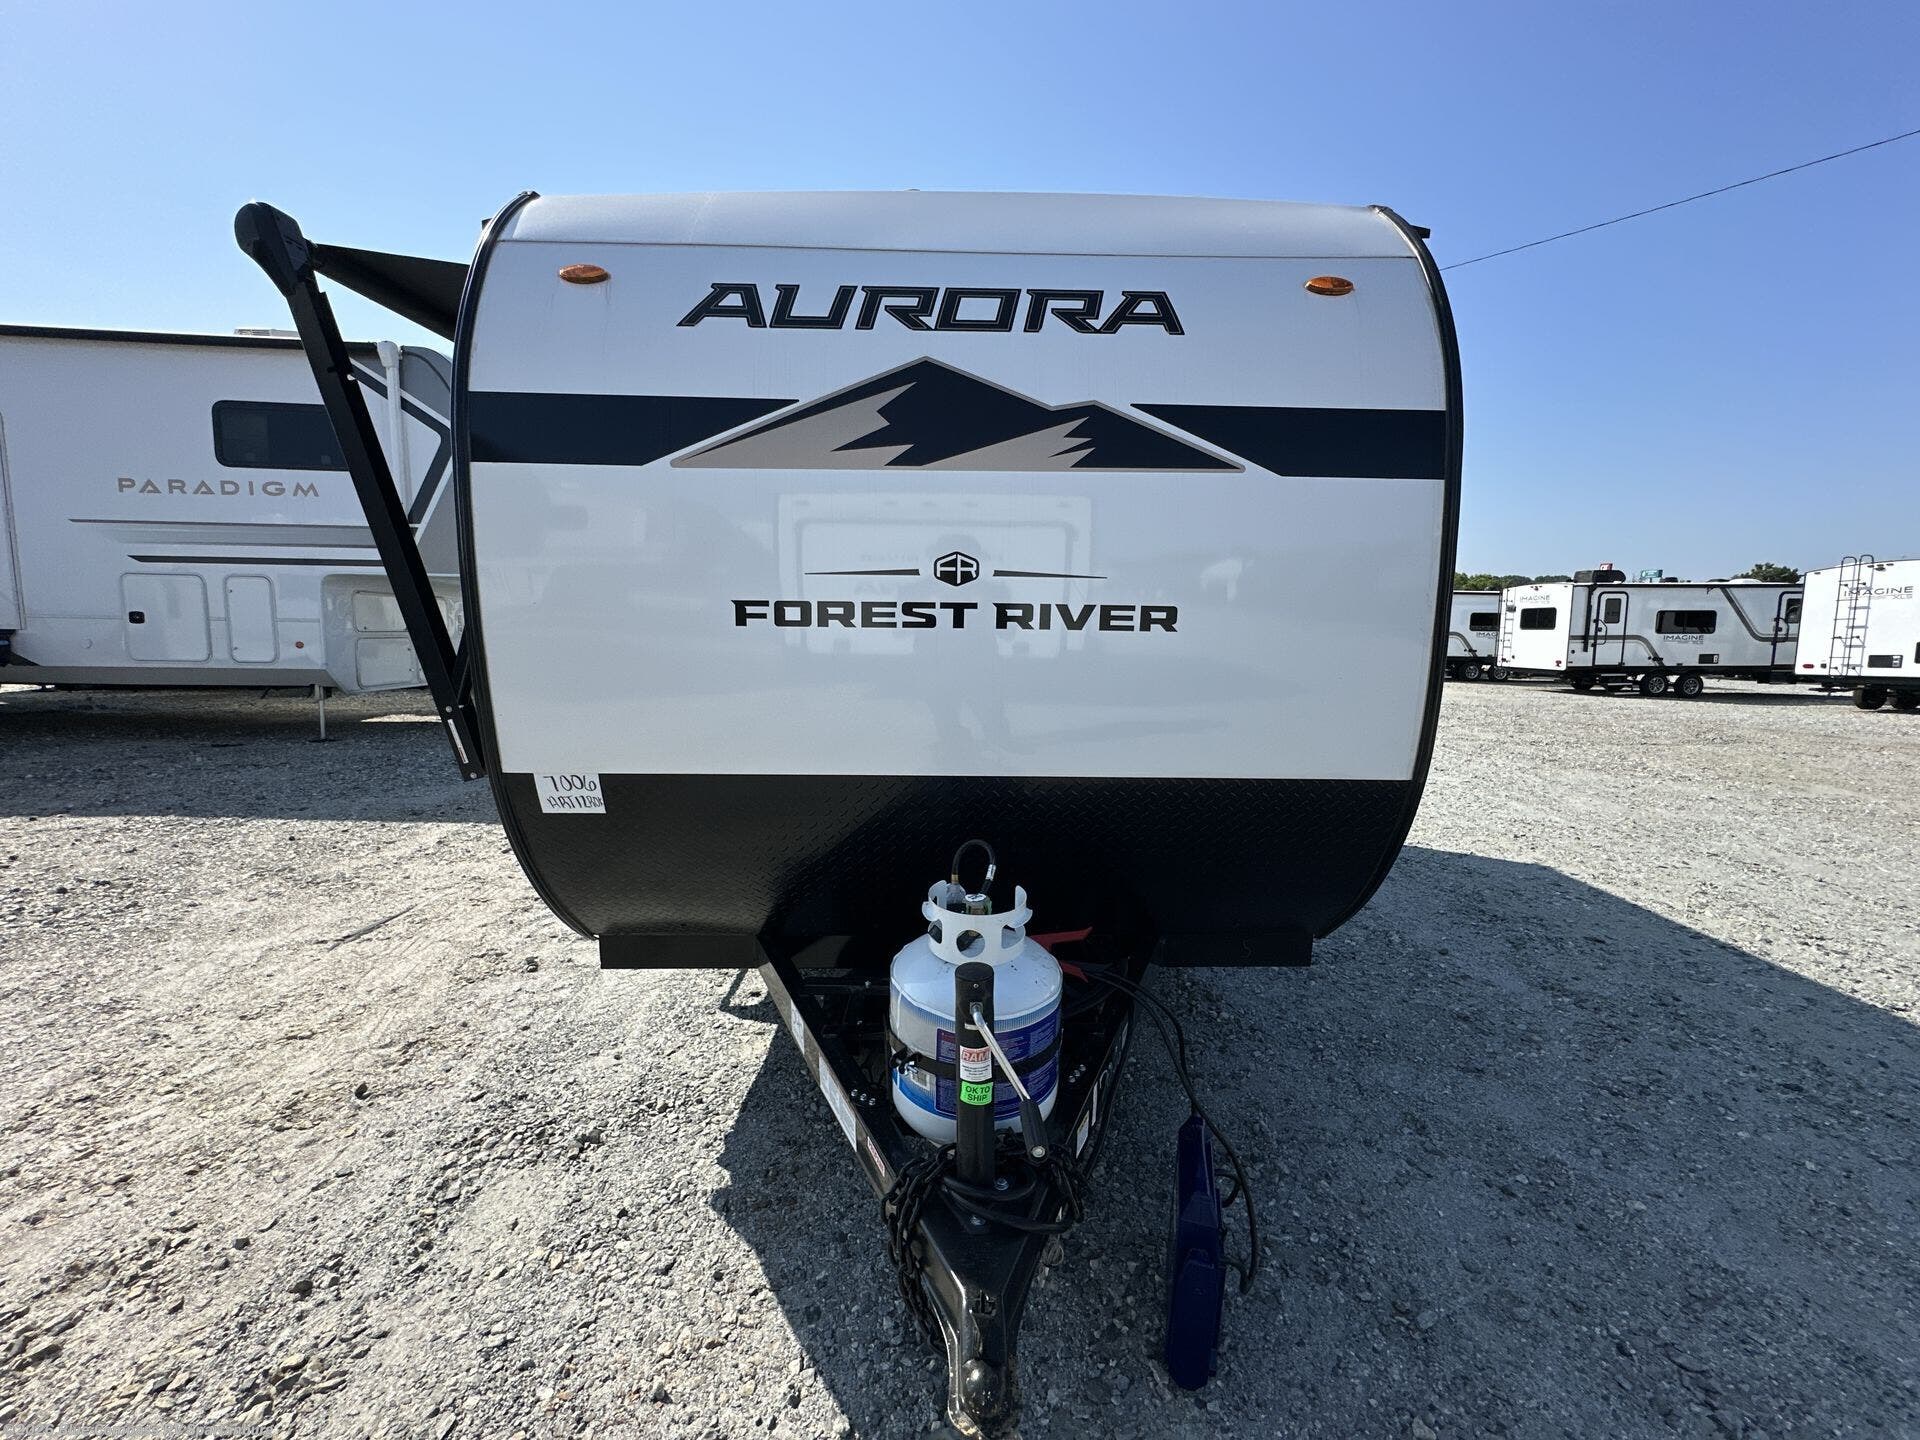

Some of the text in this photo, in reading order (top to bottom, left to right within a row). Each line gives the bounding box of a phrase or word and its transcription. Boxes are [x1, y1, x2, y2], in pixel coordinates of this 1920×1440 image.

[677, 283, 1185, 335] AURORA
[117, 478, 319, 497] PARADIGM
[1844, 585, 1913, 597] IMAGINE
[731, 600, 1179, 632] FOREST RIVER
[542, 774, 597, 791] 7006
[965, 1085, 991, 1094] OK TO
[967, 1093, 988, 1102] SHIP
